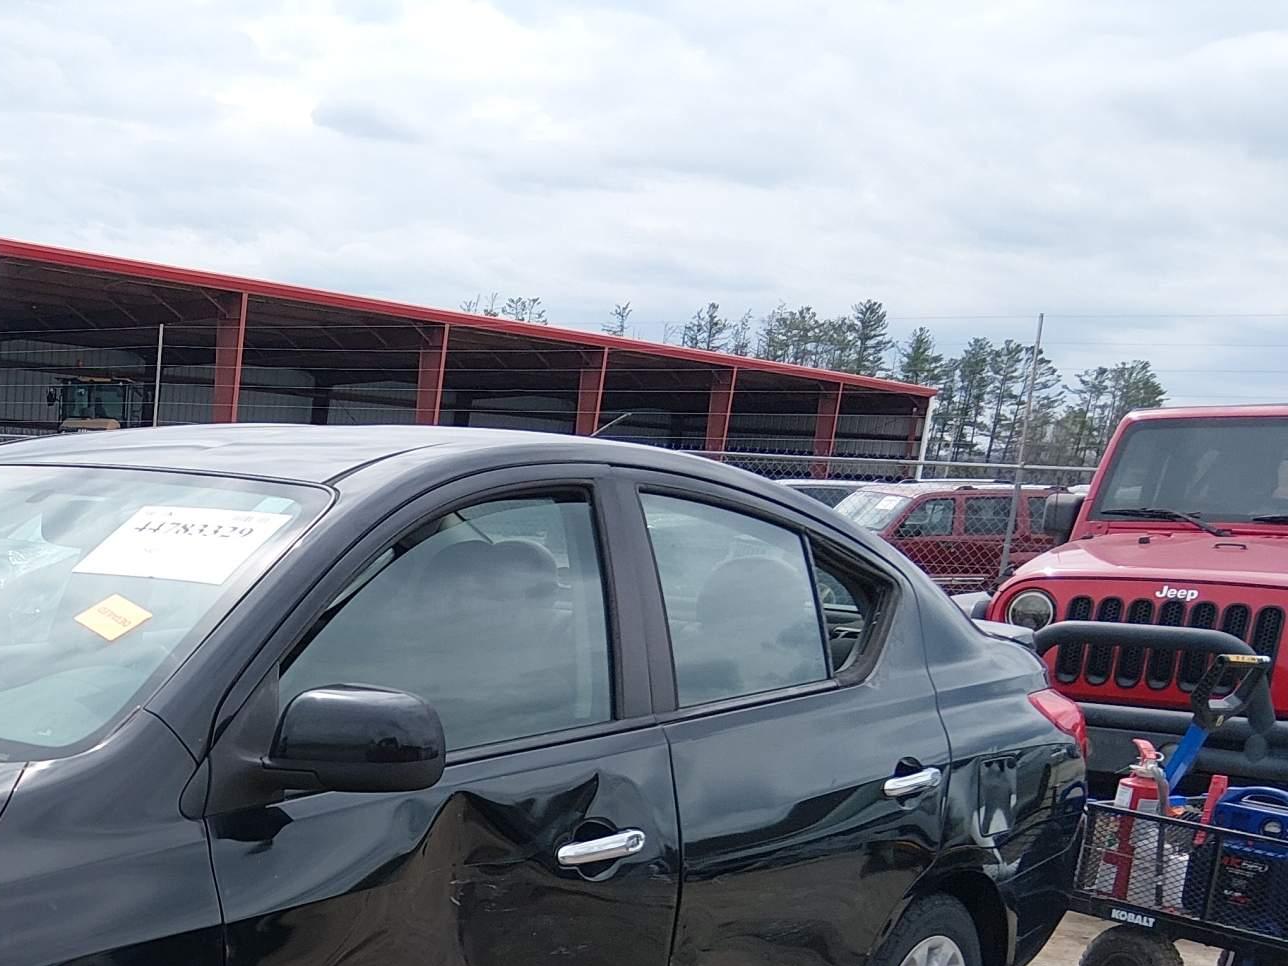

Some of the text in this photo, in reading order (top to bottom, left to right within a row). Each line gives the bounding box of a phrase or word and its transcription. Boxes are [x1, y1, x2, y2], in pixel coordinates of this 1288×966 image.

[133, 520, 254, 538] 44783329
[1155, 585, 1199, 602] Jeep
[1111, 908, 1156, 928] KOBALT
